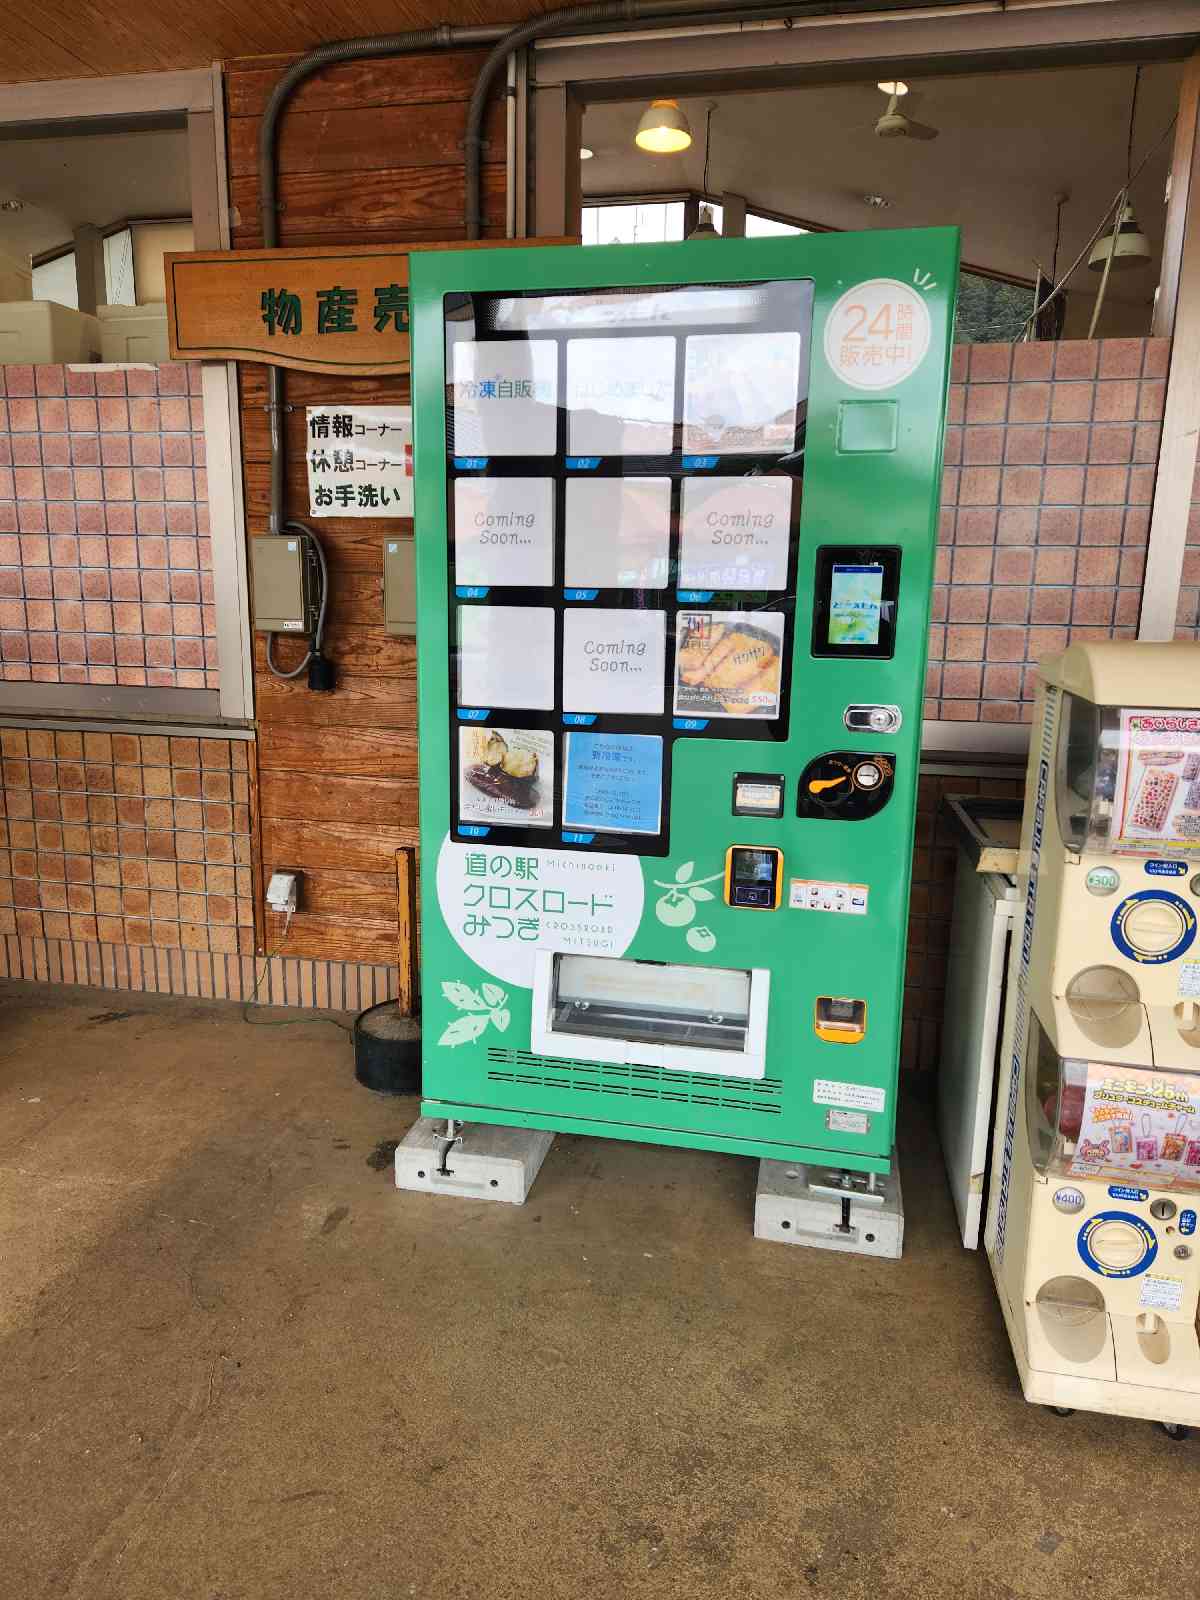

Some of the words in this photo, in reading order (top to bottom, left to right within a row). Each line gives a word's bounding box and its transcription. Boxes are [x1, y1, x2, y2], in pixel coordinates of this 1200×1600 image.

[843, 303, 895, 342] 24
[309, 414, 402, 438] 情報コーナー
[311, 449, 402, 473] 休憩コーナー
[314, 484, 401, 507] お手洗い
[474, 510, 536, 528] Coming
[706, 510, 775, 528] Coming
[583, 639, 647, 657] Coming
[464, 852, 540, 881] 道の駅
[464, 883, 614, 917] クロスロード
[463, 914, 540, 942] みつぎ
